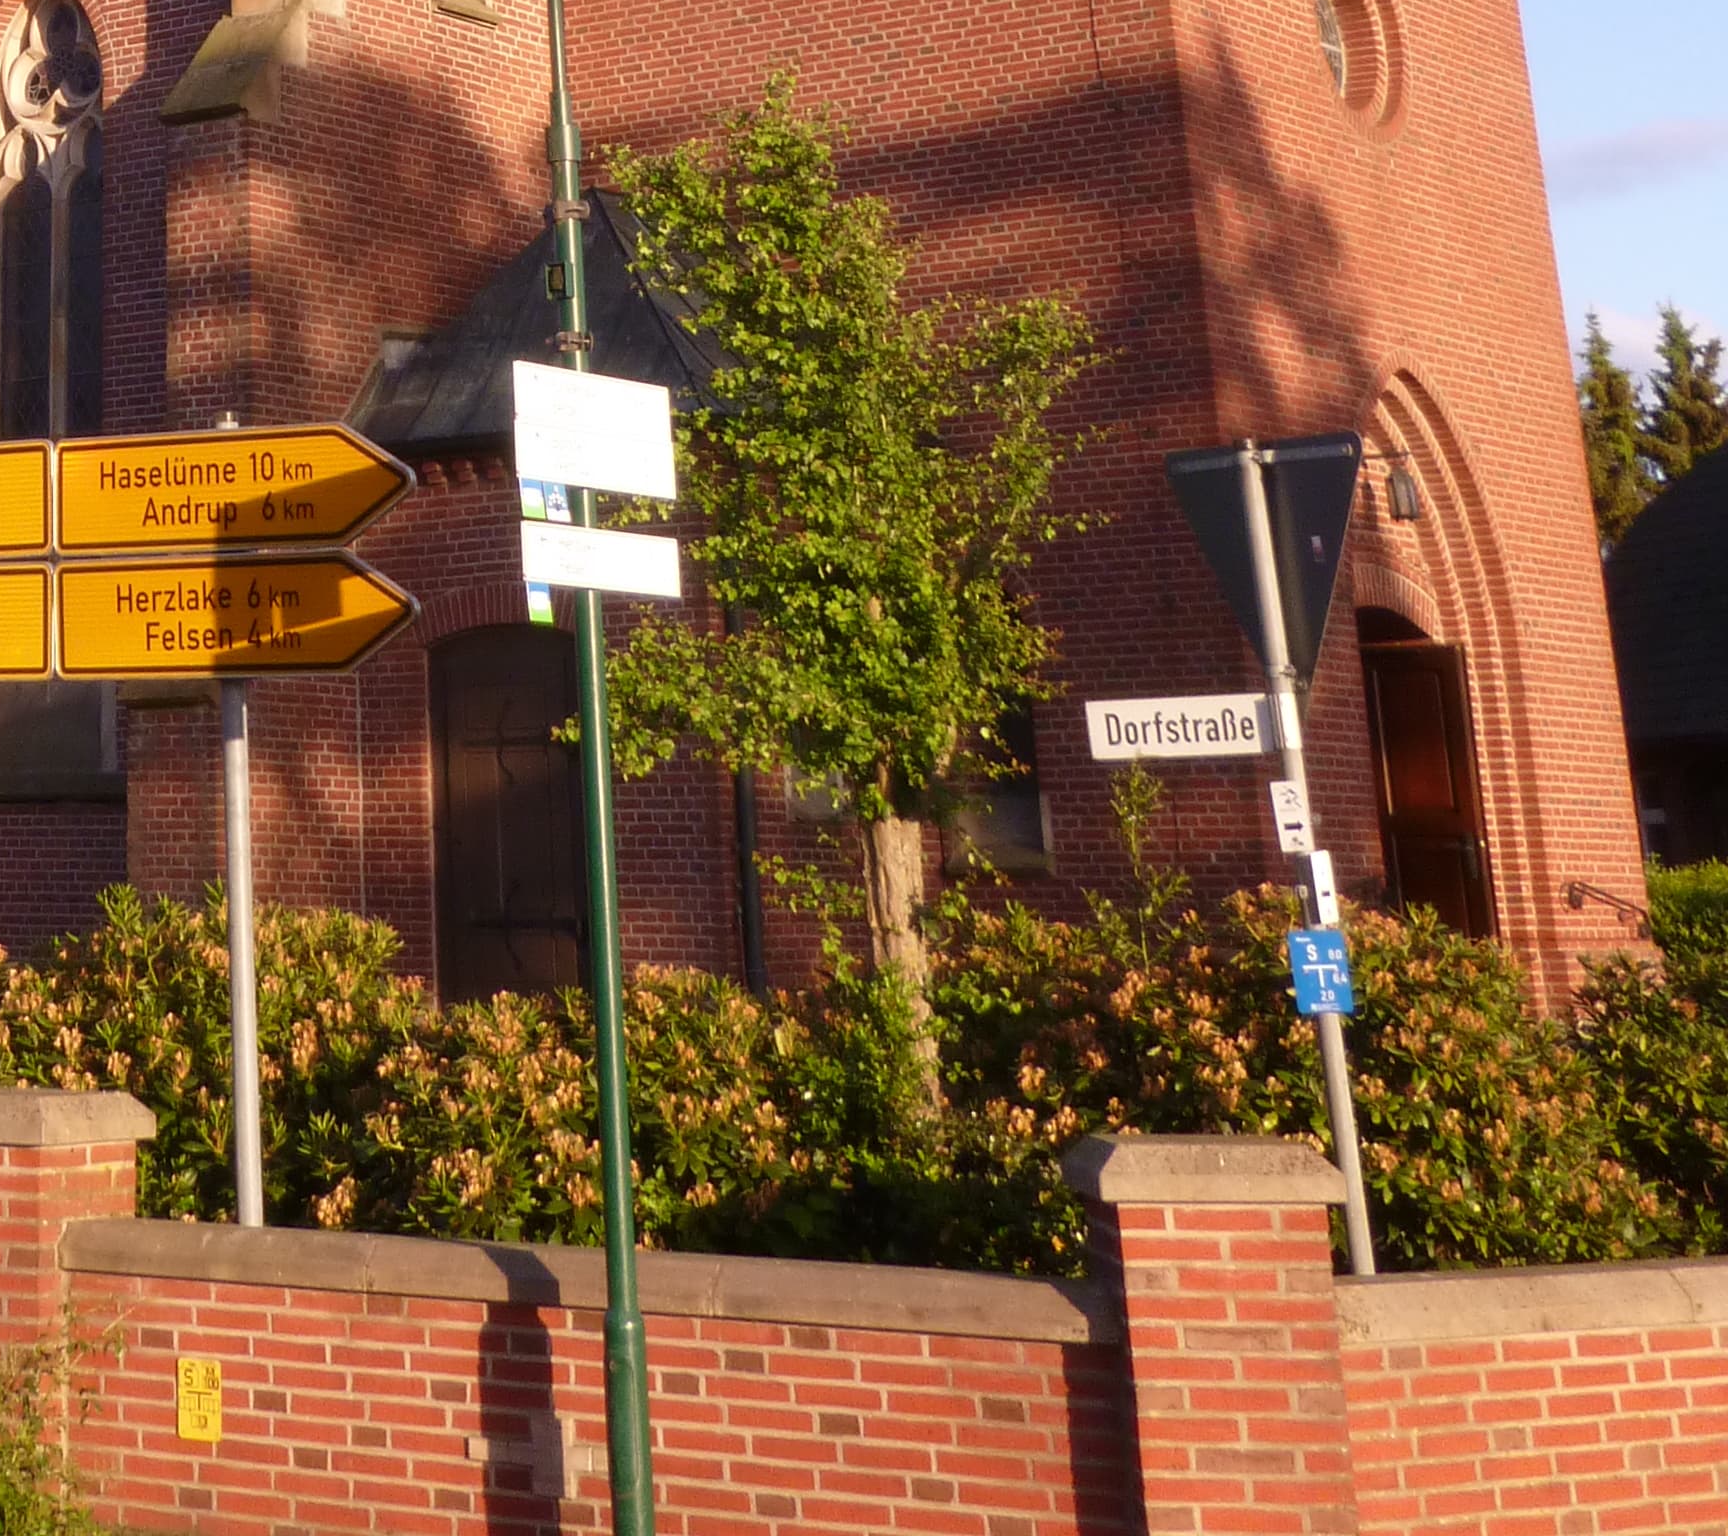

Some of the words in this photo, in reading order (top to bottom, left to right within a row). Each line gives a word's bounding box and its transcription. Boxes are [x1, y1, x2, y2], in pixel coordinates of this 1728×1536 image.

[100, 456, 237, 490] Haselünne
[249, 451, 274, 482] 10
[282, 458, 313, 481] km
[142, 495, 238, 531] Andrup
[262, 491, 276, 521] 6
[283, 498, 314, 520] km
[116, 580, 232, 613] Herzlake
[247, 578, 261, 609] 6
[268, 585, 300, 608] km
[145, 620, 233, 651] Felsen
[247, 618, 261, 649] 4
[270, 625, 302, 649] km
[1104, 708, 1255, 746] Dorfstraße
[1306, 944, 1318, 961] S
[184, 1369, 193, 1386] S
